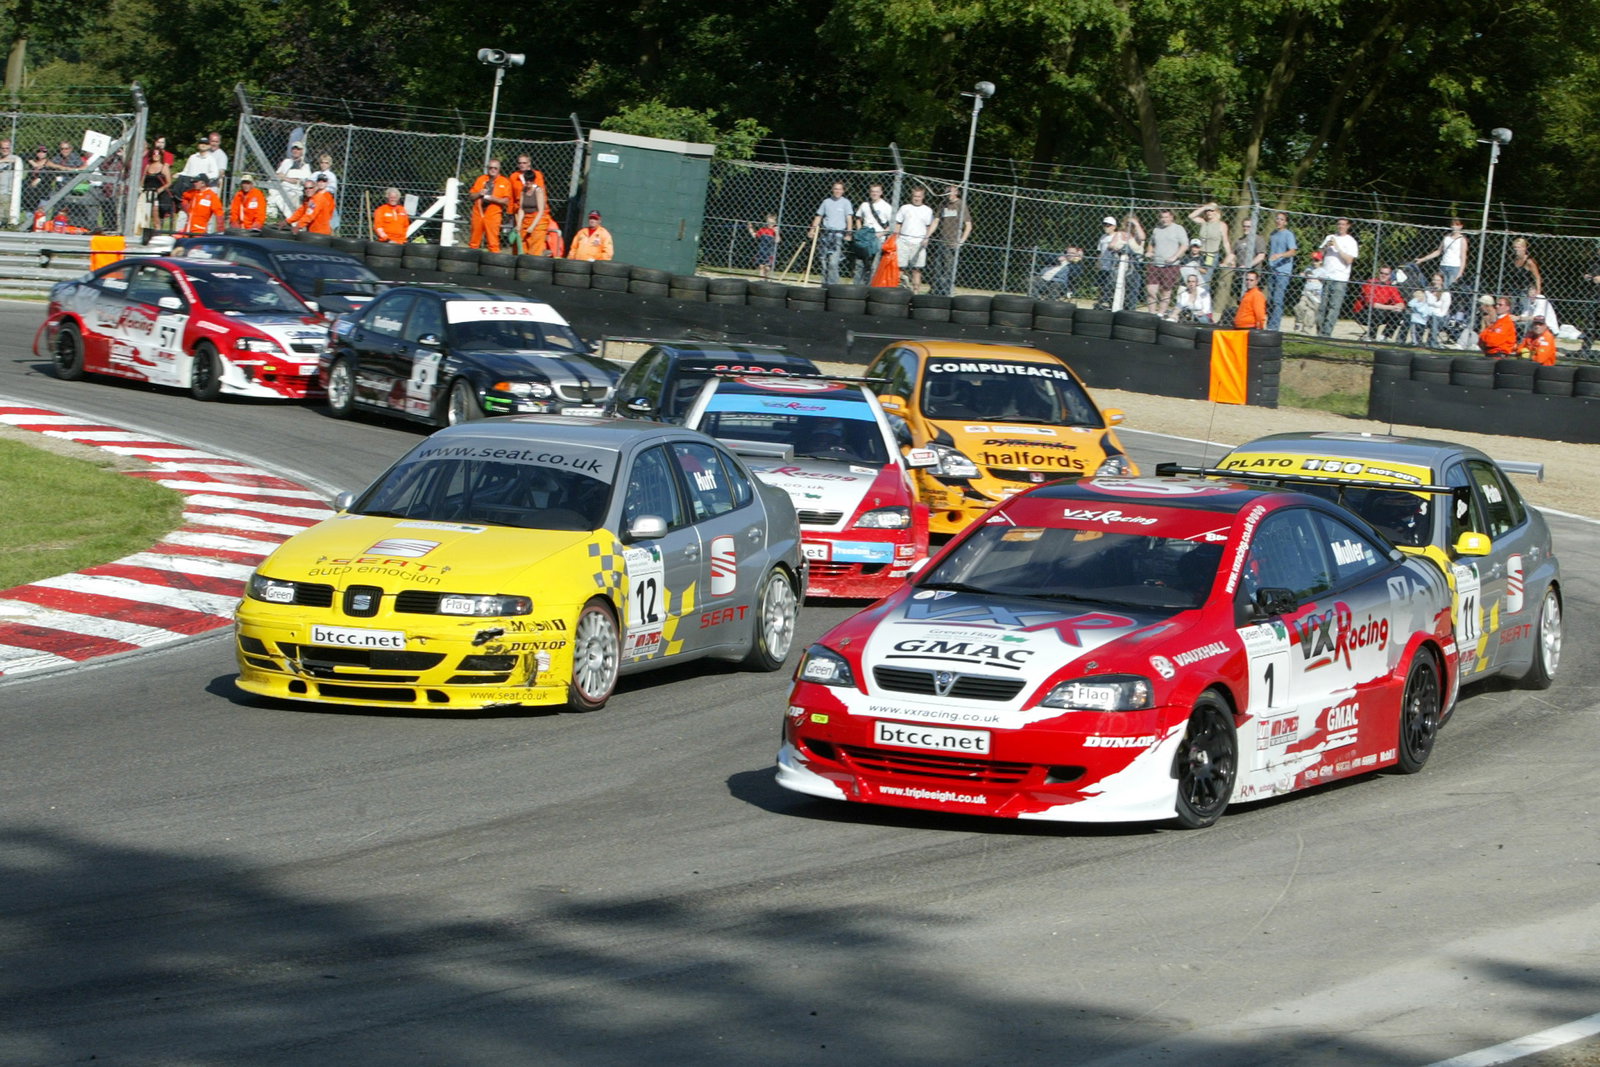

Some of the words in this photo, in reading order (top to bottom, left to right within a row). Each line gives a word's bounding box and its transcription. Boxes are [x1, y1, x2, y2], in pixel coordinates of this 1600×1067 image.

[160, 326, 176, 348] 57
[929, 363, 1069, 380] COMPUTEACH
[419, 448, 603, 474] www.seat.co.uk
[984, 452, 1085, 469] halfords
[1226, 458, 1293, 470] PLATO
[1302, 458, 1364, 475] 150
[693, 470, 717, 491] Huff
[1368, 467, 1391, 476] NOT
[1393, 472, 1418, 483] OUT
[1331, 540, 1365, 566] Muller
[329, 557, 437, 571] SEAT
[308, 566, 351, 577] auto
[357, 567, 441, 585] emoción
[268, 588, 293, 600] Green
[636, 577, 658, 625] 12
[445, 600, 471, 613] Flag
[700, 605, 749, 629] SEAT
[1463, 595, 1475, 641] 11
[315, 628, 401, 647] btcc.net
[1500, 624, 1532, 645] SEAT
[510, 640, 566, 651] DUNLOP
[893, 640, 1035, 663] GMAC
[1173, 641, 1230, 667] VAUXHALL
[806, 662, 832, 676] Green
[1078, 687, 1109, 702] Flag
[1264, 662, 1274, 708] 1
[470, 691, 548, 700] www.seat.co.uk
[868, 703, 1000, 723] www.vxracing.co.uk
[1327, 702, 1359, 731] GMAC
[880, 725, 984, 751] btcc.net
[1083, 736, 1155, 748] DUNLOP
[879, 785, 987, 804] www.tripleeight.co.uk
